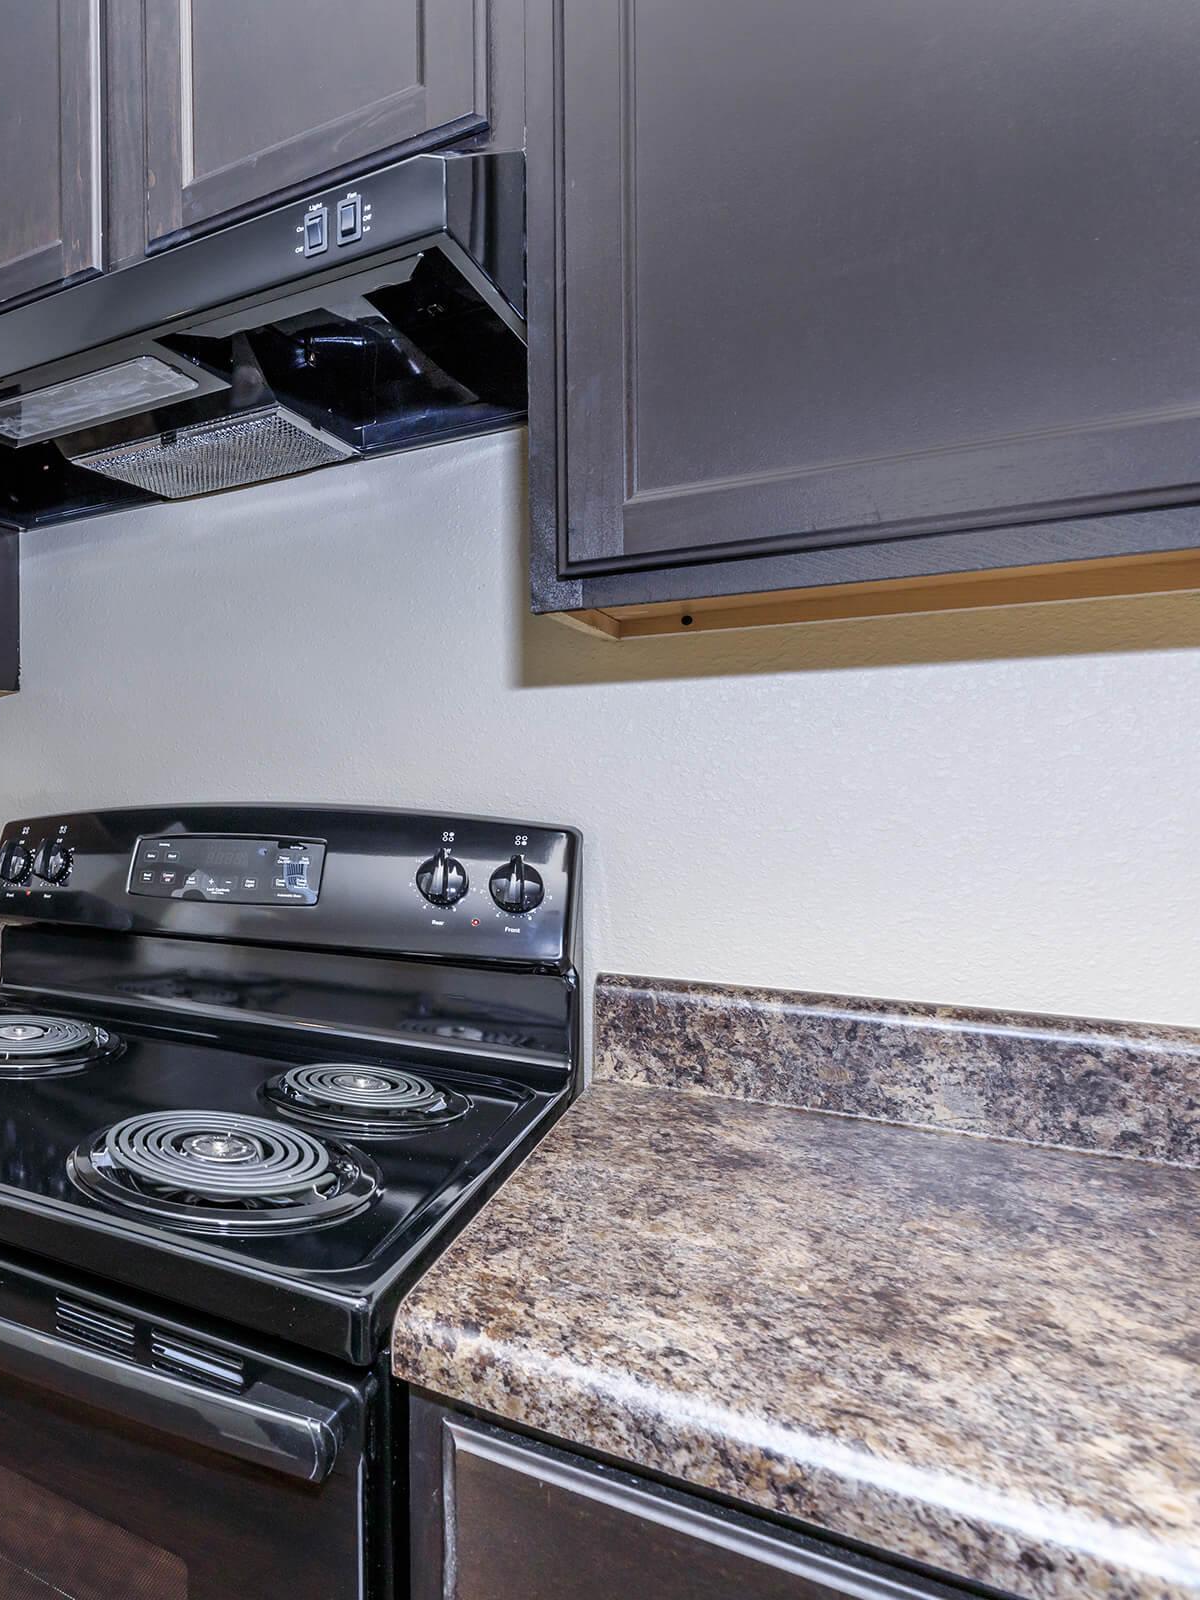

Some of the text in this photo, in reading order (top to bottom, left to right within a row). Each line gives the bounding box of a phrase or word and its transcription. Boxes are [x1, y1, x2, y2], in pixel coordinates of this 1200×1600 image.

[346, 192, 357, 200] Fan
[308, 203, 323, 211] Light
[504, 926, 521, 934] Front
